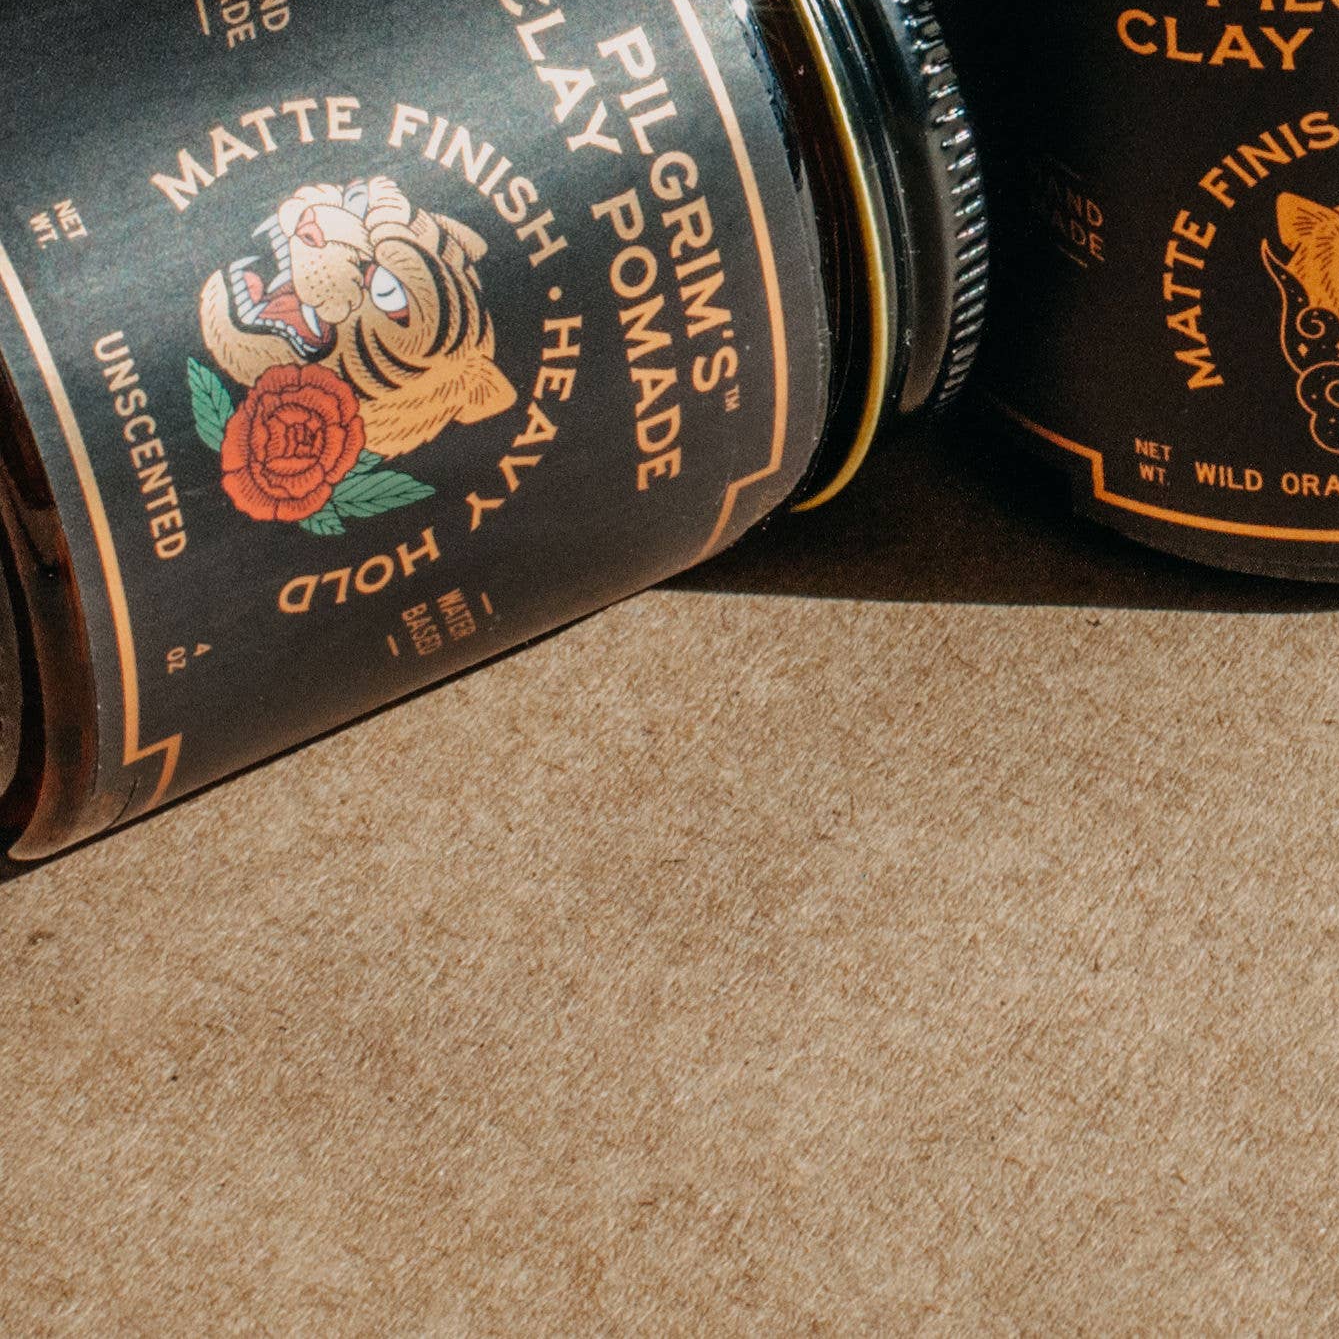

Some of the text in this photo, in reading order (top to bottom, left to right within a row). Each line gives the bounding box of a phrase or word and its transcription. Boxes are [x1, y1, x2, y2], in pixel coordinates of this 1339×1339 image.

[1117, 8, 1313, 71] CLAY
[53, 198, 89, 241] NET
[1162, 209, 1224, 390] MATTE
[149, 96, 583, 614] MATTE FINISH HEAVY HOLD
[590, 188, 682, 491] POMADE
[94, 329, 188, 559] UNSCENTED
[1134, 437, 1172, 462] NET
[1194, 461, 1264, 492] WILD
[193, 643, 212, 657] 4
